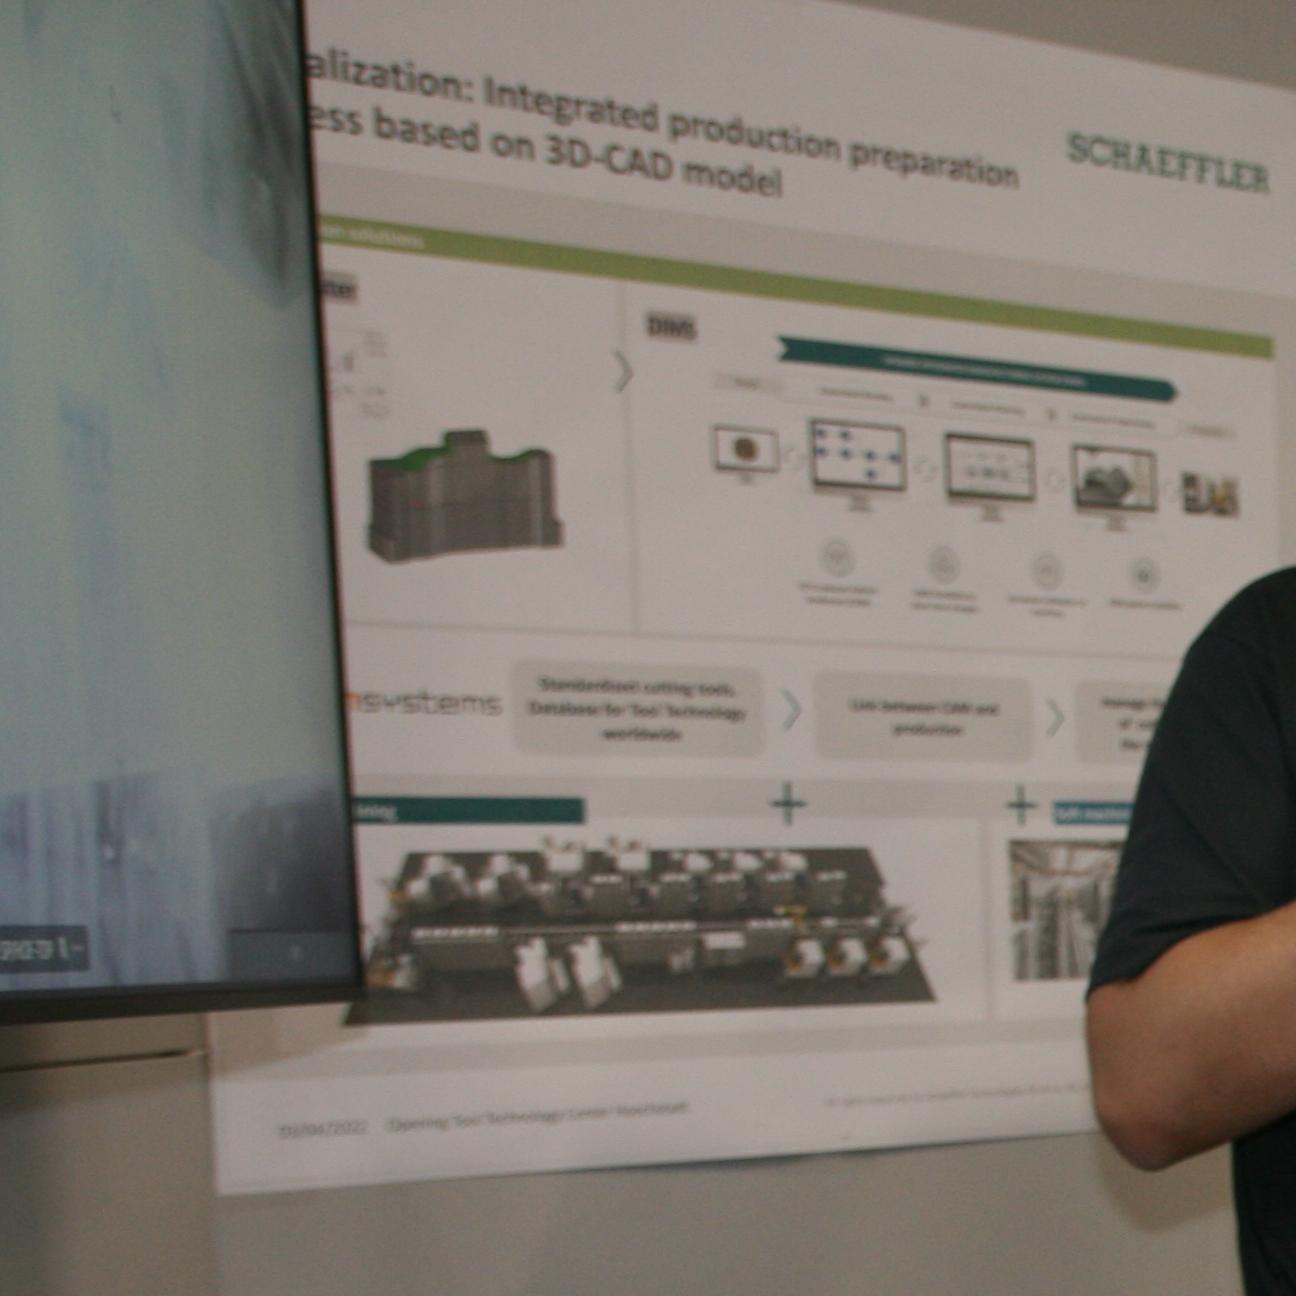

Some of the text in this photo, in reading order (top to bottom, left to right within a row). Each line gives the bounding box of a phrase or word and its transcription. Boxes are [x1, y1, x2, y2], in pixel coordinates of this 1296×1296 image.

[374, 106, 480, 152] based
[491, 134, 536, 160] on
[546, 135, 673, 181] 3D-CAD
[683, 164, 783, 198] model
[484, 75, 659, 132] Integrated
[668, 111, 841, 162] production
[850, 142, 1020, 189] preparation
[1066, 130, 1271, 194] SCHAEFFLER
